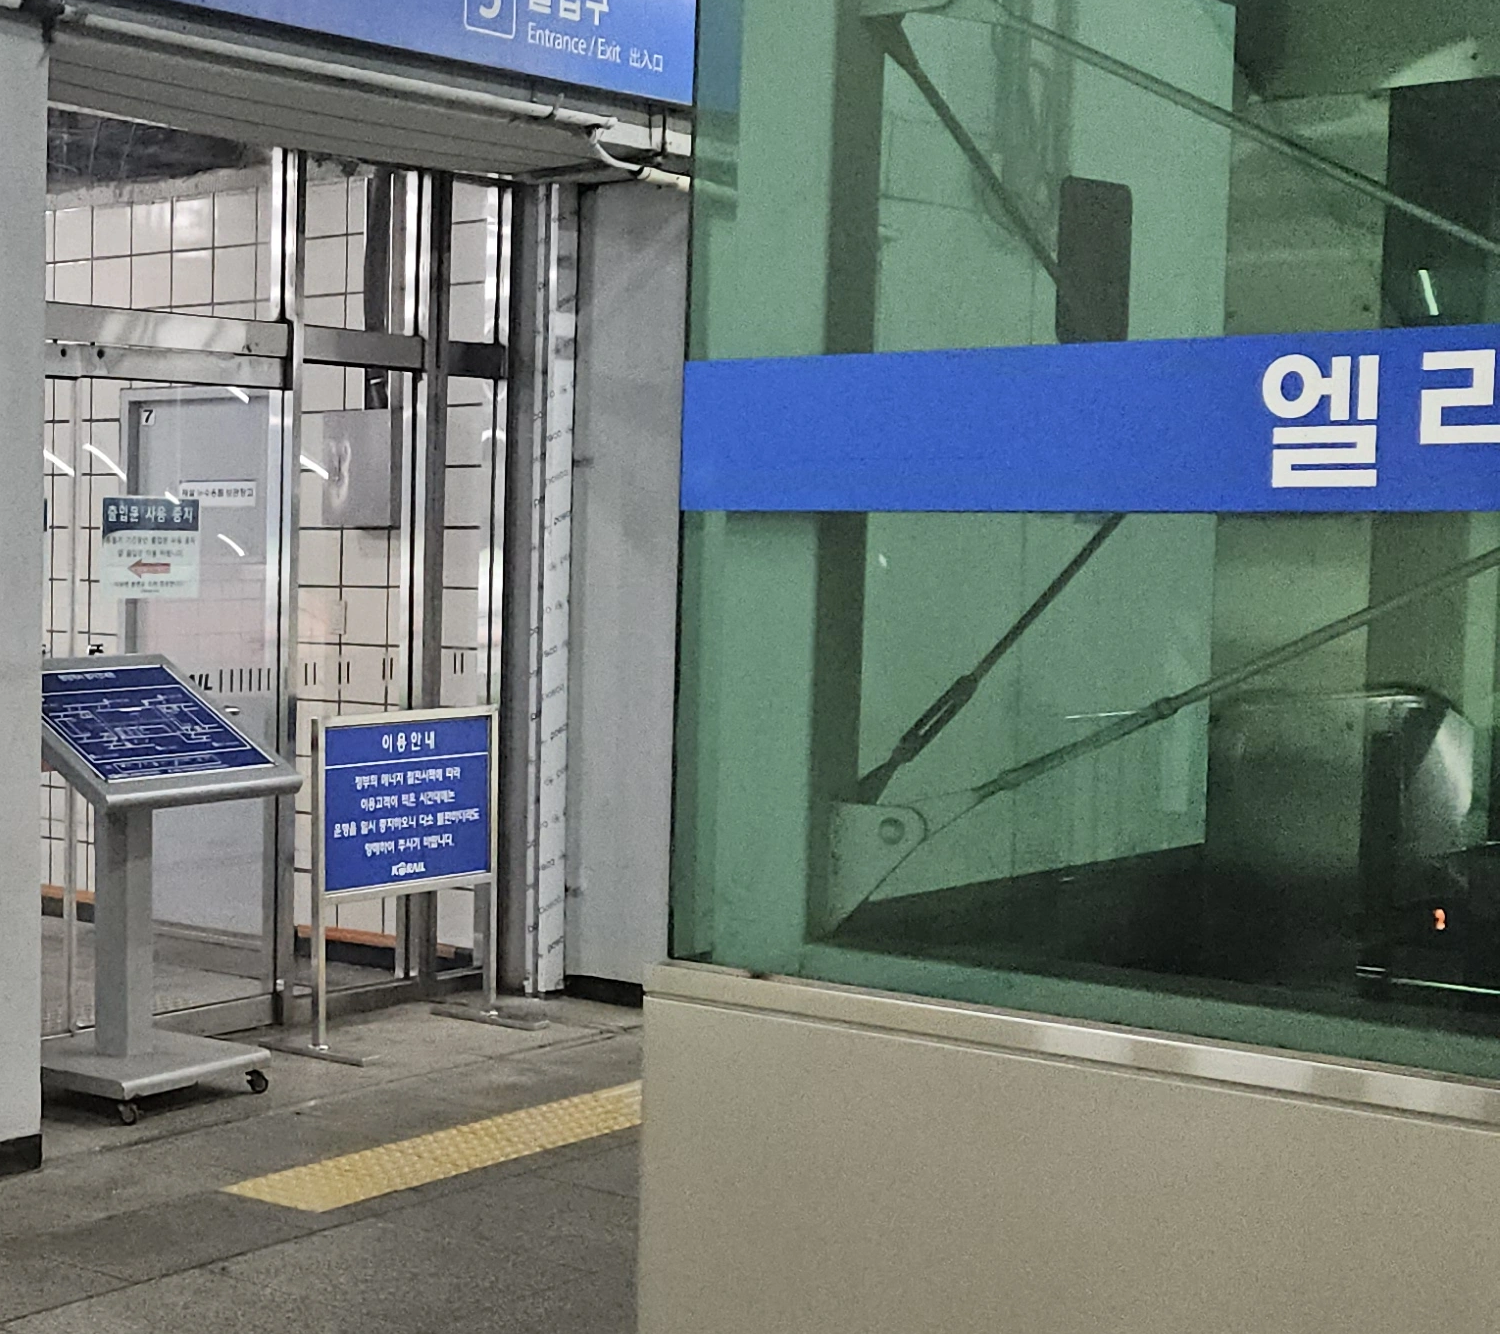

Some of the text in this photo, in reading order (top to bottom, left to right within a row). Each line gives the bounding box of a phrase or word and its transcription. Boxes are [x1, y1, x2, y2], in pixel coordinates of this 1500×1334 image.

[527, 22, 587, 57] Entrance
[597, 37, 622, 64] Exit
[629, 46, 664, 73] 出入口
[142, 408, 154, 424] 7
[145, 505, 168, 523] 사용
[381, 730, 436, 754] 이용안내
